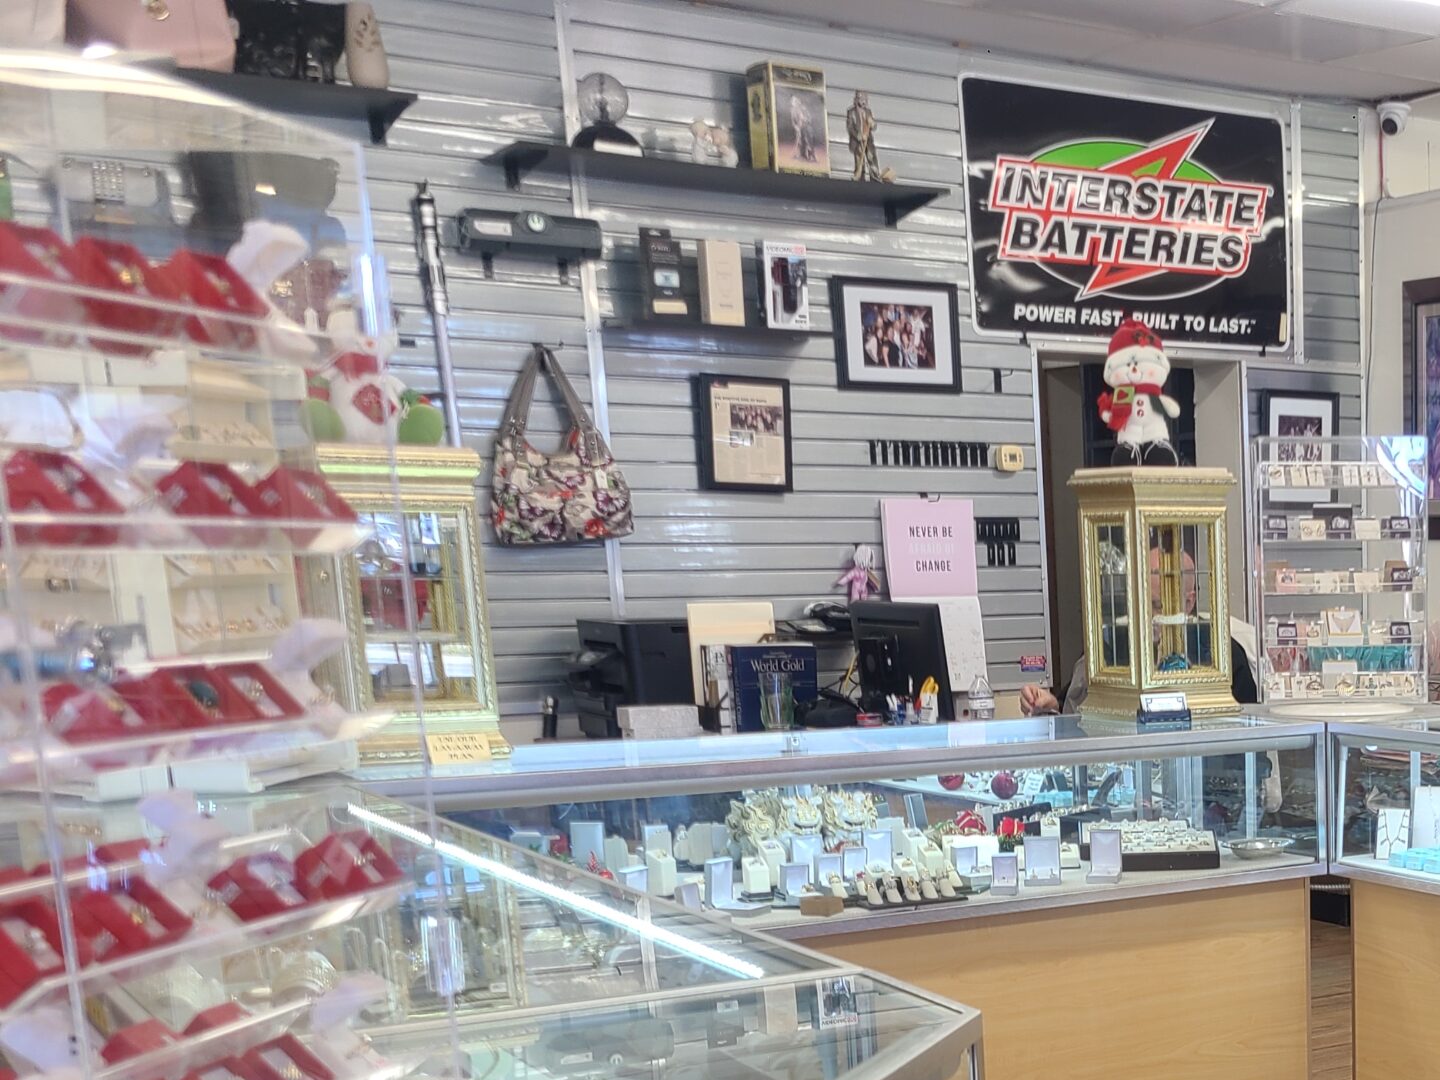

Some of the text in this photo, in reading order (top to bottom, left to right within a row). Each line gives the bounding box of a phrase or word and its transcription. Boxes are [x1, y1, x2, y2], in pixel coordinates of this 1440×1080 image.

[998, 165, 1264, 230] INTERSTATE
[1008, 215, 1248, 272] BATTERIES
[1013, 303, 1077, 325] POWER
[1183, 315, 1205, 332] TO
[908, 526, 953, 538] NEVER BE
[915, 560, 952, 572] CHANGE
[750, 658, 805, 673] World Gold
